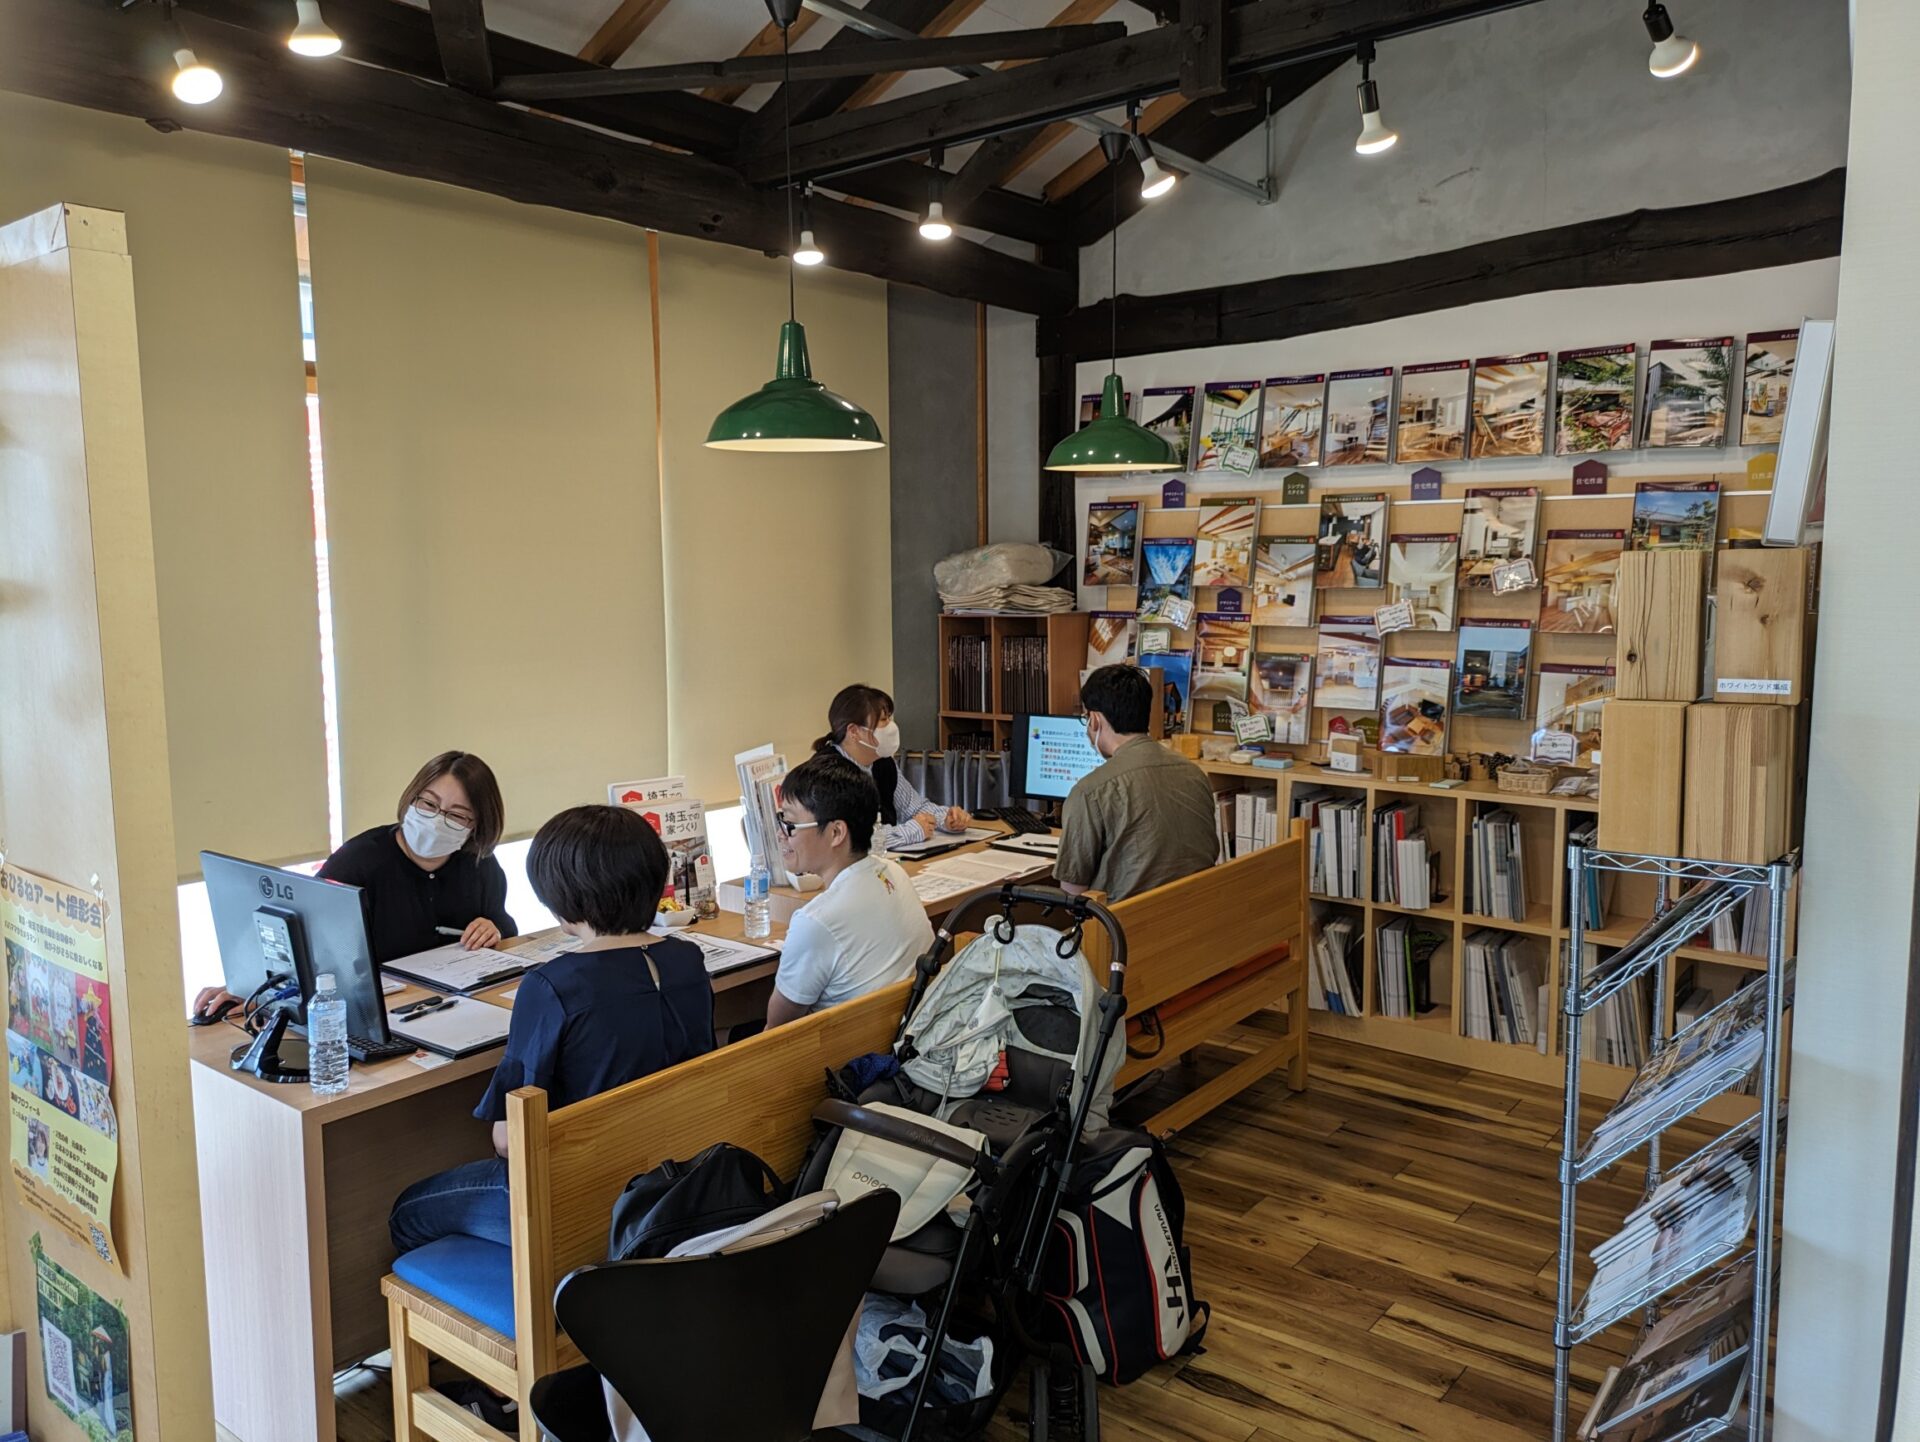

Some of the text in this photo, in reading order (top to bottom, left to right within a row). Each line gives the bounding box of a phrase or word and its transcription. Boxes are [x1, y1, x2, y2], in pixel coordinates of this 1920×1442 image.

[1414, 482, 1439, 490] 住宅性能
[1576, 477, 1603, 485] 住宅性能
[664, 810, 700, 824] 埼玉での
[666, 822, 698, 836] 家づくり
[276, 883, 294, 900] LG
[0, 871, 102, 928] おひるねアート撮影会
[1154, 1203, 1180, 1274] HATAKEYAMA
